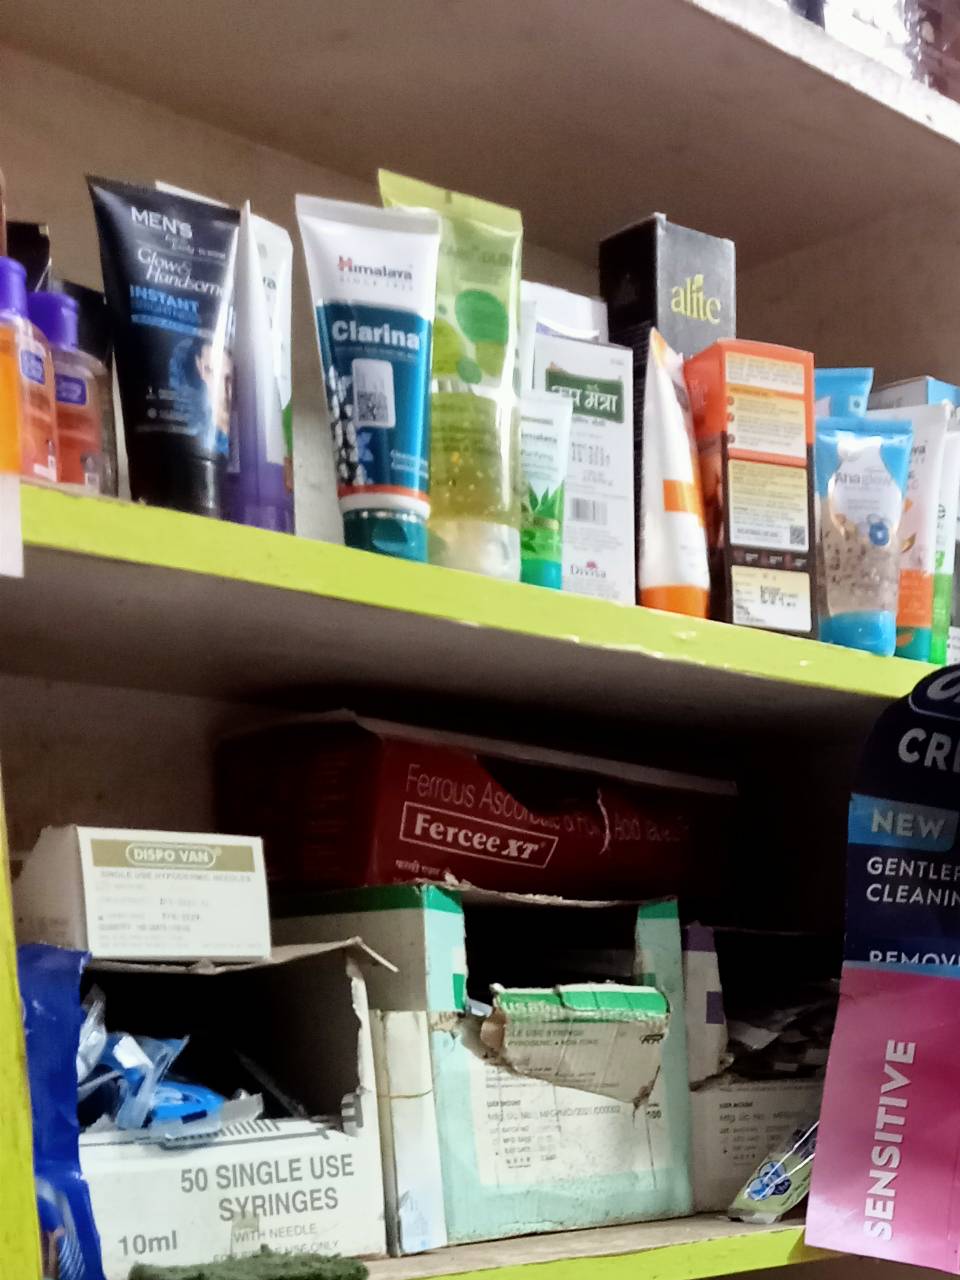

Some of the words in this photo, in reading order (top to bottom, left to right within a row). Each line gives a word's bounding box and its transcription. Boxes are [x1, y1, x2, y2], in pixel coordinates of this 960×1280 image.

[331, 320, 420, 351] Clarina
[406, 763, 476, 807] Ferrous
[413, 813, 502, 852] Fercee
[501, 840, 541, 861] XT
[871, 806, 944, 839] NEW
[133, 848, 176, 861] DISPO
[178, 849, 210, 863] VAN
[863, 1038, 917, 1241] SENSITIVE
[180, 1167, 209, 1193] 50
[215, 1158, 303, 1190] SINGLE
[309, 1154, 355, 1180] USE
[218, 1187, 339, 1222] SYRINGES
[118, 1230, 178, 1257] 10ml
[233, 1229, 266, 1244] WITH
[269, 1223, 318, 1240] NEEDLE
